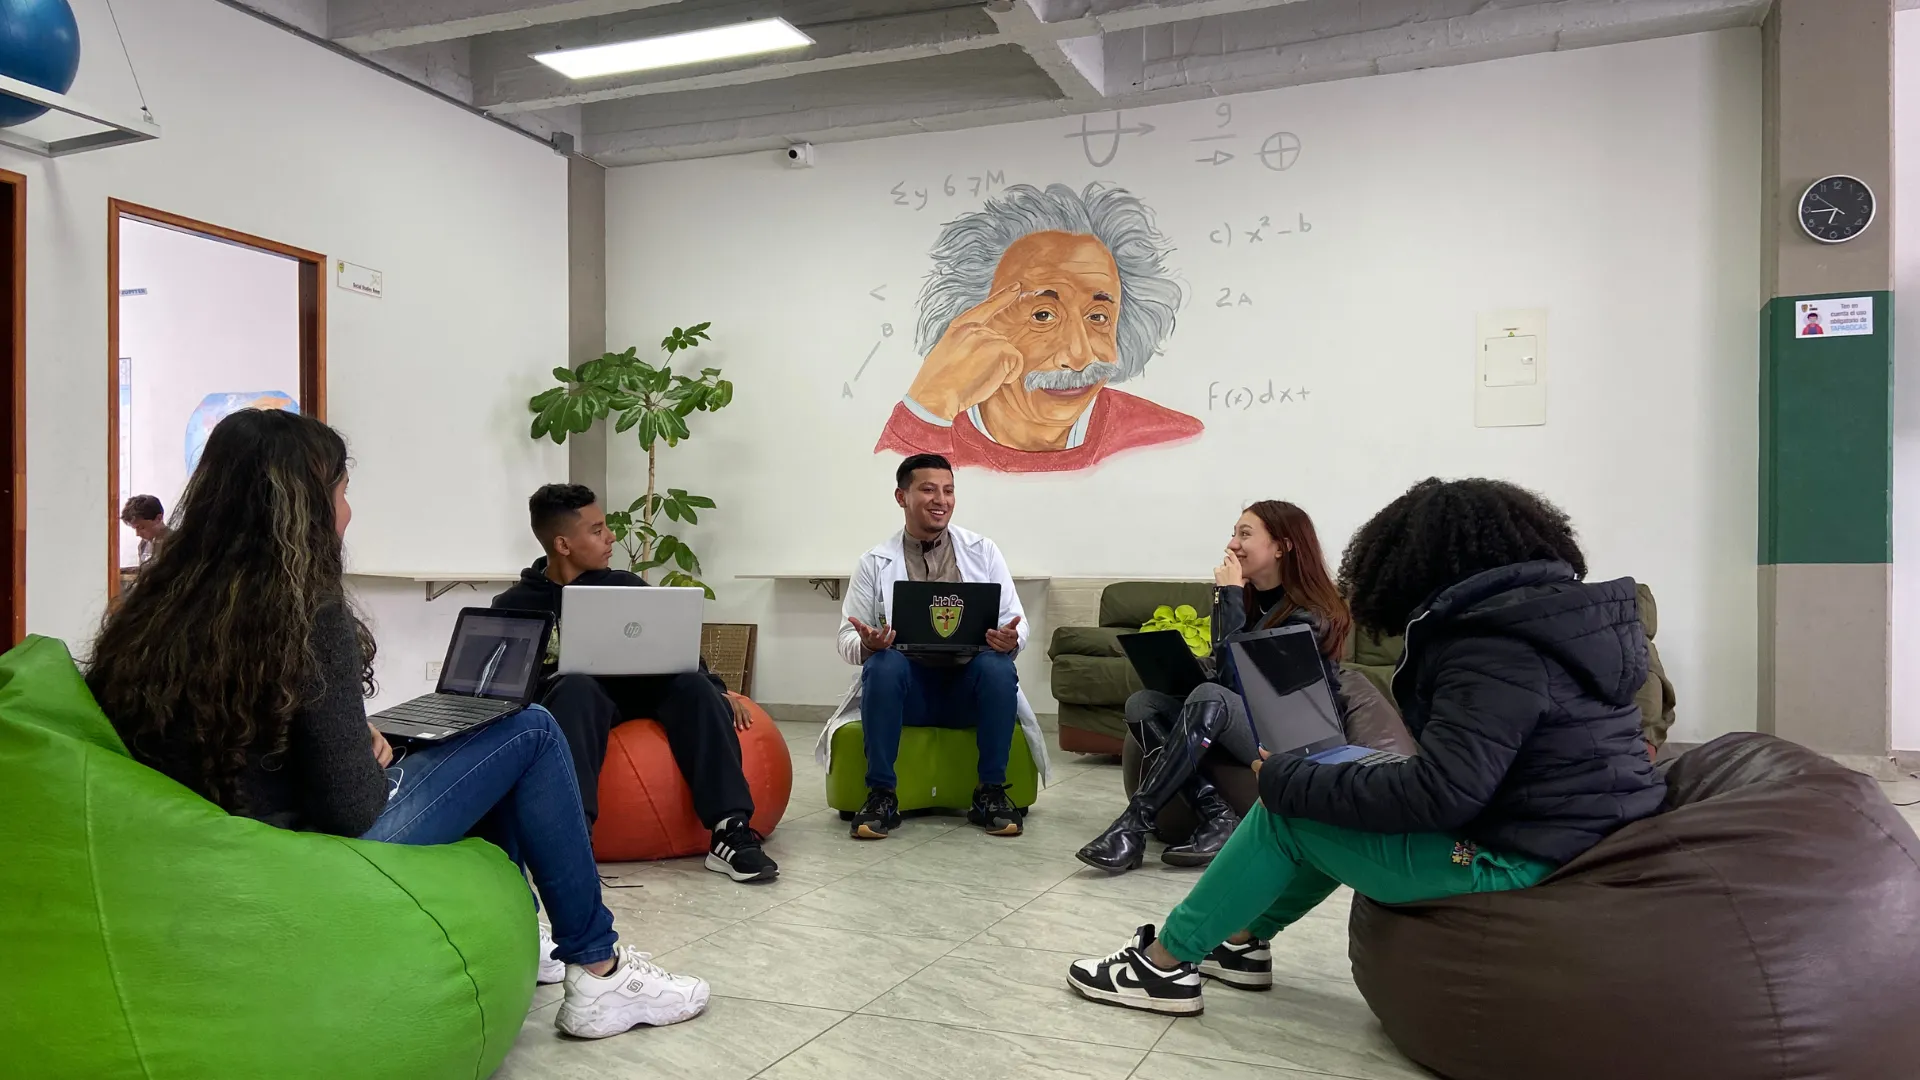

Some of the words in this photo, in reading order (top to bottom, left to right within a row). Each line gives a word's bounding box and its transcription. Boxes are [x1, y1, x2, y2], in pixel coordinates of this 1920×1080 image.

[1819, 184, 1827, 192] 11
[1833, 180, 1842, 189] 12
[1857, 192, 1865, 201] 2
[1861, 205, 1869, 214] 3
[1808, 218, 1815, 228] 8
[1817, 227, 1825, 235] 7
[1829, 231, 1838, 239] 6
[1830, 323, 1867, 332] TAPABOCAS
